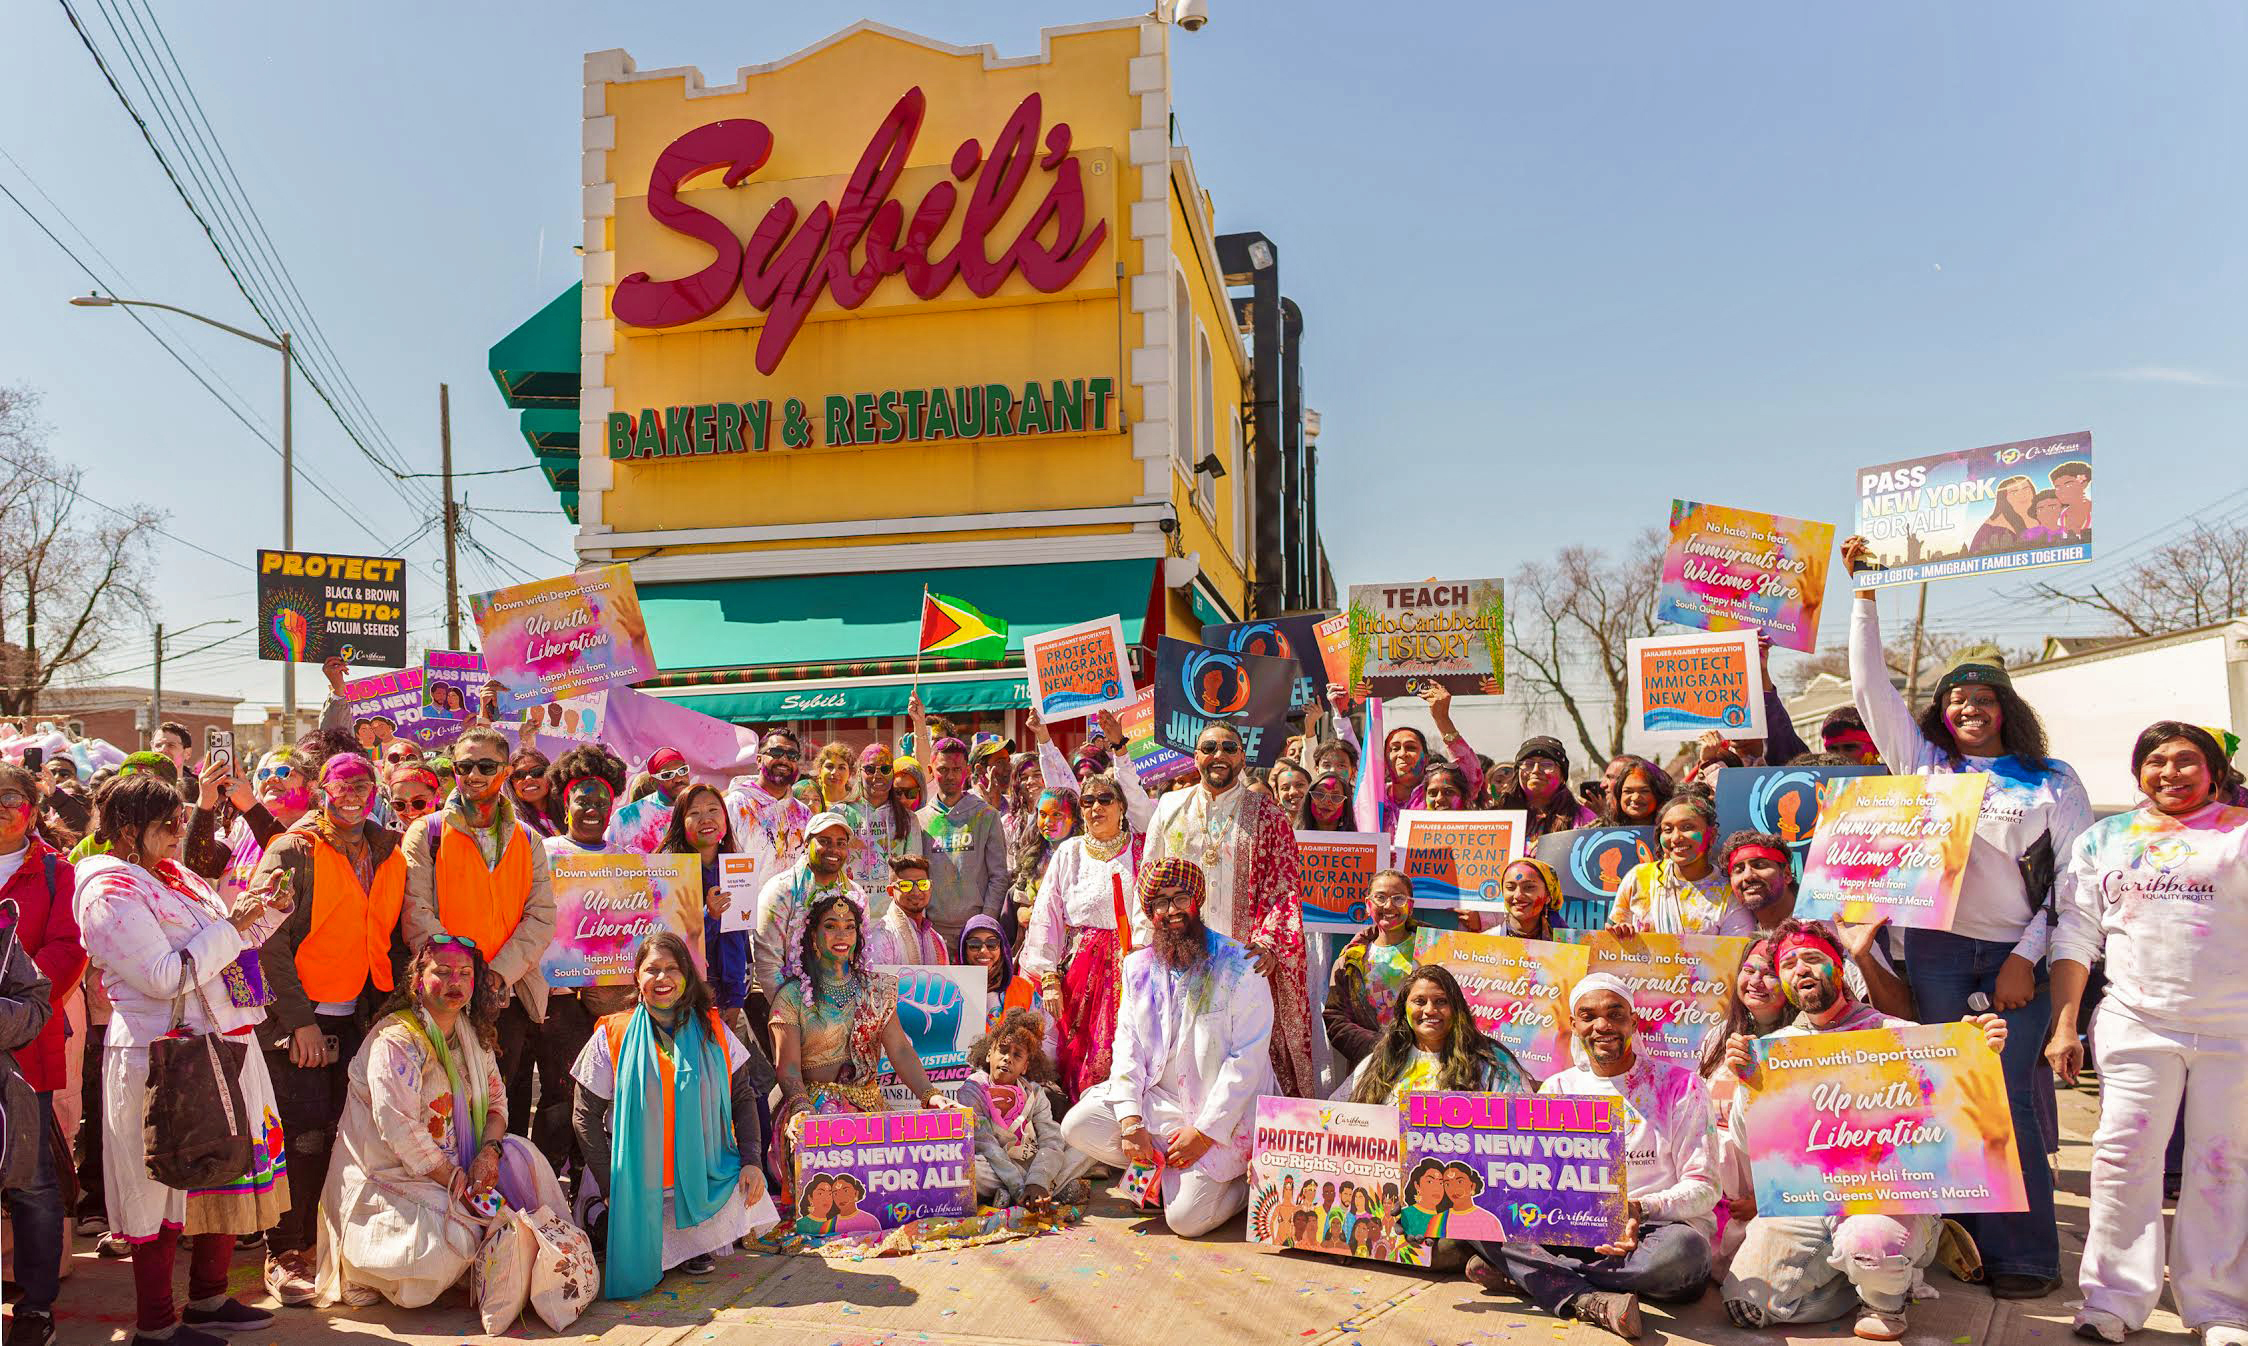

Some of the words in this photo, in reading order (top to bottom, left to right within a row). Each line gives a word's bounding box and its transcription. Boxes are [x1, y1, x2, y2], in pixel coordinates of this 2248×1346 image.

[612, 85, 1108, 376] Sybil's
[608, 398, 772, 460] BAKERY
[782, 396, 813, 449] &
[824, 377, 1114, 446] RESTAURANT
[2026, 443, 2079, 460] Caribbean
[1862, 465, 1927, 496] PASS
[1862, 487, 1921, 519] NEW
[1927, 477, 1997, 509] YORK
[1706, 522, 1720, 533] No
[1723, 524, 1748, 540] hate,
[1767, 531, 1789, 545] fear
[1862, 513, 1913, 540] FOR
[1910, 508, 1955, 533] ALL
[1683, 533, 1777, 569] Immigrants
[1777, 557, 1807, 575] are
[262, 552, 401, 582] PROTECT
[1860, 571, 1883, 586] KEEP
[1885, 568, 1919, 583] LGBTQ+
[1922, 560, 1979, 577] IMMIGRANT
[1982, 553, 2028, 569] FAMILIES
[2031, 547, 2083, 562] TOGETHER
[1683, 560, 1753, 592] Welcome
[1756, 575, 1800, 600] Here
[326, 586, 353, 600] BLACK
[356, 589, 362, 600] &
[365, 589, 399, 602] BROWN
[494, 600, 523, 612] Down
[526, 595, 548, 606] with
[550, 582, 610, 601] Deportation
[1383, 586, 1468, 608] TEACH
[1702, 592, 1729, 607] Happy
[1731, 598, 1748, 610] Holi
[1749, 601, 1768, 613] from
[325, 601, 400, 621] LGBTQ+
[1358, 610, 1497, 634] Indo-Caribbean
[1675, 600, 1697, 612] South
[1699, 605, 1729, 618] Queens
[1731, 610, 1767, 625] Women's
[1768, 619, 1797, 632] March
[326, 621, 361, 635] ASYLUM
[363, 623, 399, 637] SEEKERS
[526, 615, 550, 639] Up
[554, 608, 590, 630] with
[526, 631, 610, 664] Liberation
[1047, 640, 1102, 663] PROTECT
[1377, 633, 1473, 660] HISTORY
[1701, 646, 1742, 654] DEPORTATION
[427, 669, 458, 681] PASS
[539, 670, 566, 683] Happy
[568, 666, 585, 677] Holi
[586, 662, 606, 673] from
[1040, 652, 1113, 678] IMMIGRANT
[1656, 656, 1731, 673] PROTECT
[514, 689, 538, 701] South
[540, 683, 571, 694] Queens
[572, 673, 608, 687] Women's
[611, 666, 638, 679] March
[1045, 676, 1072, 692] NEW
[1078, 666, 1114, 684] YORK
[1644, 672, 1744, 689] IMMIGRANT
[382, 693, 417, 709] NEW
[780, 694, 846, 712] Sybil's
[1649, 691, 1686, 705] NEW
[1695, 688, 1743, 703] YORK
[1856, 796, 1870, 806] No
[1423, 833, 1497, 846] PROTECT
[1831, 813, 1923, 843] Immigrants
[1923, 821, 1952, 836] are
[1409, 848, 1507, 860] IMMIGRANT
[1826, 842, 1895, 866] Welcome
[1899, 845, 1941, 869] Here
[556, 868, 586, 878] Down
[590, 868, 612, 877] with
[615, 868, 678, 879] Deportation
[1411, 862, 1449, 875] NEW
[1456, 864, 1500, 877] YORK
[1321, 886, 1369, 899] YORK
[1840, 877, 1866, 889] Happy
[1868, 878, 1885, 888] Holi
[1887, 880, 1906, 889] from
[2103, 870, 2216, 904] Caribbean
[583, 890, 607, 914] Up
[613, 890, 650, 911] with
[1813, 891, 1834, 900] South
[1836, 892, 1864, 902] Queens
[1866, 893, 1903, 904] Women's
[1906, 896, 1934, 907] March
[575, 916, 665, 939] Liberation
[584, 954, 613, 965] Happy
[616, 952, 634, 961] Holi
[1454, 950, 1468, 960] No
[1472, 951, 1498, 965] hate,
[1519, 957, 1541, 969] fear
[1599, 950, 1616, 960] No
[1621, 950, 1651, 964] hate,
[1656, 955, 1670, 963] no
[1675, 953, 1701, 965] fear
[555, 968, 580, 977] South
[583, 968, 616, 977] Queens
[1530, 984, 1561, 999] are
[1691, 980, 1727, 995] are
[1509, 1001, 1555, 1028] Here
[1670, 1000, 1721, 1025] Here
[1641, 1033, 1661, 1042] Holi
[1664, 1033, 1688, 1044] from
[1522, 1051, 1552, 1062] March
[1768, 1056, 1812, 1070] Down
[1817, 1052, 1851, 1065] with
[1856, 1046, 1957, 1066] Deportation
[1811, 1084, 1850, 1118] Up
[1856, 1081, 1917, 1110] with
[1335, 1113, 1369, 1126] Caribbean
[1410, 1096, 1508, 1129] HOLI
[1515, 1097, 1613, 1133] HAI!
[805, 1117, 885, 1147] HOLI
[890, 1113, 965, 1143] HAI!
[1258, 1127, 1324, 1154] PROTECT
[1806, 1119, 1946, 1152] Liberation
[801, 1150, 854, 1169] PASS
[858, 1147, 906, 1166] NEW
[908, 1143, 964, 1163] YORK
[1407, 1132, 1470, 1154] PASS
[1474, 1133, 1534, 1156] NEW
[1538, 1136, 1611, 1160] YORK
[1261, 1152, 1288, 1168] Our
[1289, 1155, 1340, 1175] Rights,
[1343, 1160, 1371, 1177] Our
[869, 1169, 919, 1193] FOR
[923, 1166, 970, 1190] ALL
[1487, 1162, 1552, 1190] FOR
[1557, 1165, 1619, 1193] ALL
[1822, 1171, 1867, 1186] Happy
[1870, 1170, 1898, 1182] Holi
[1901, 1169, 1934, 1181] from
[1782, 1191, 1819, 1202] South
[1822, 1190, 1873, 1203] Queens
[1876, 1188, 1938, 1201] Women's
[1941, 1186, 1989, 1199] March
[916, 1204, 962, 1218] Caribbean
[1548, 1209, 1608, 1225] Caribbean
